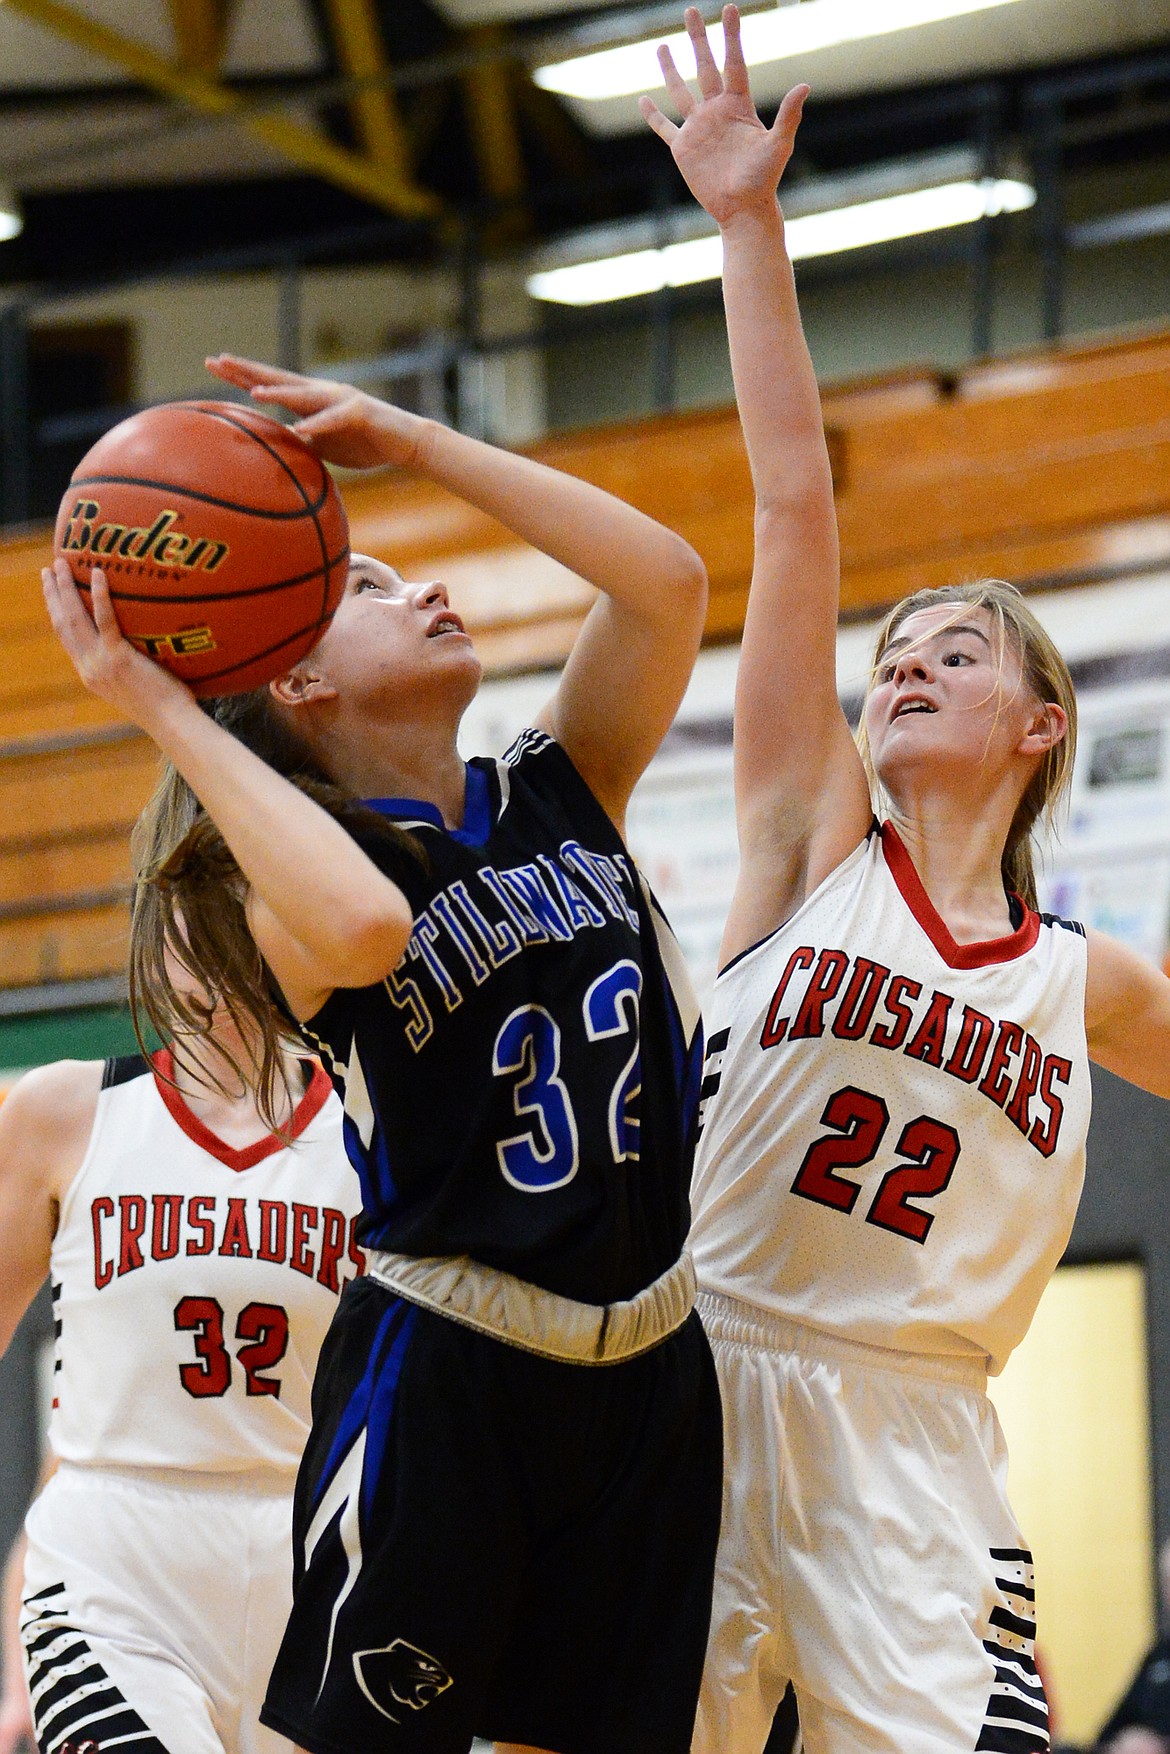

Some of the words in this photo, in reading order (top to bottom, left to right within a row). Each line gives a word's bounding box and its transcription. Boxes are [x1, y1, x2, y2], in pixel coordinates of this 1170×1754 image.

[61, 499, 229, 574] Baden
[384, 840, 640, 1053] STILLWATE
[492, 959, 643, 1193] 32
[759, 946, 1073, 1159] CRUSADERS
[789, 1085, 961, 1245] 22
[173, 1296, 289, 1399] 32
